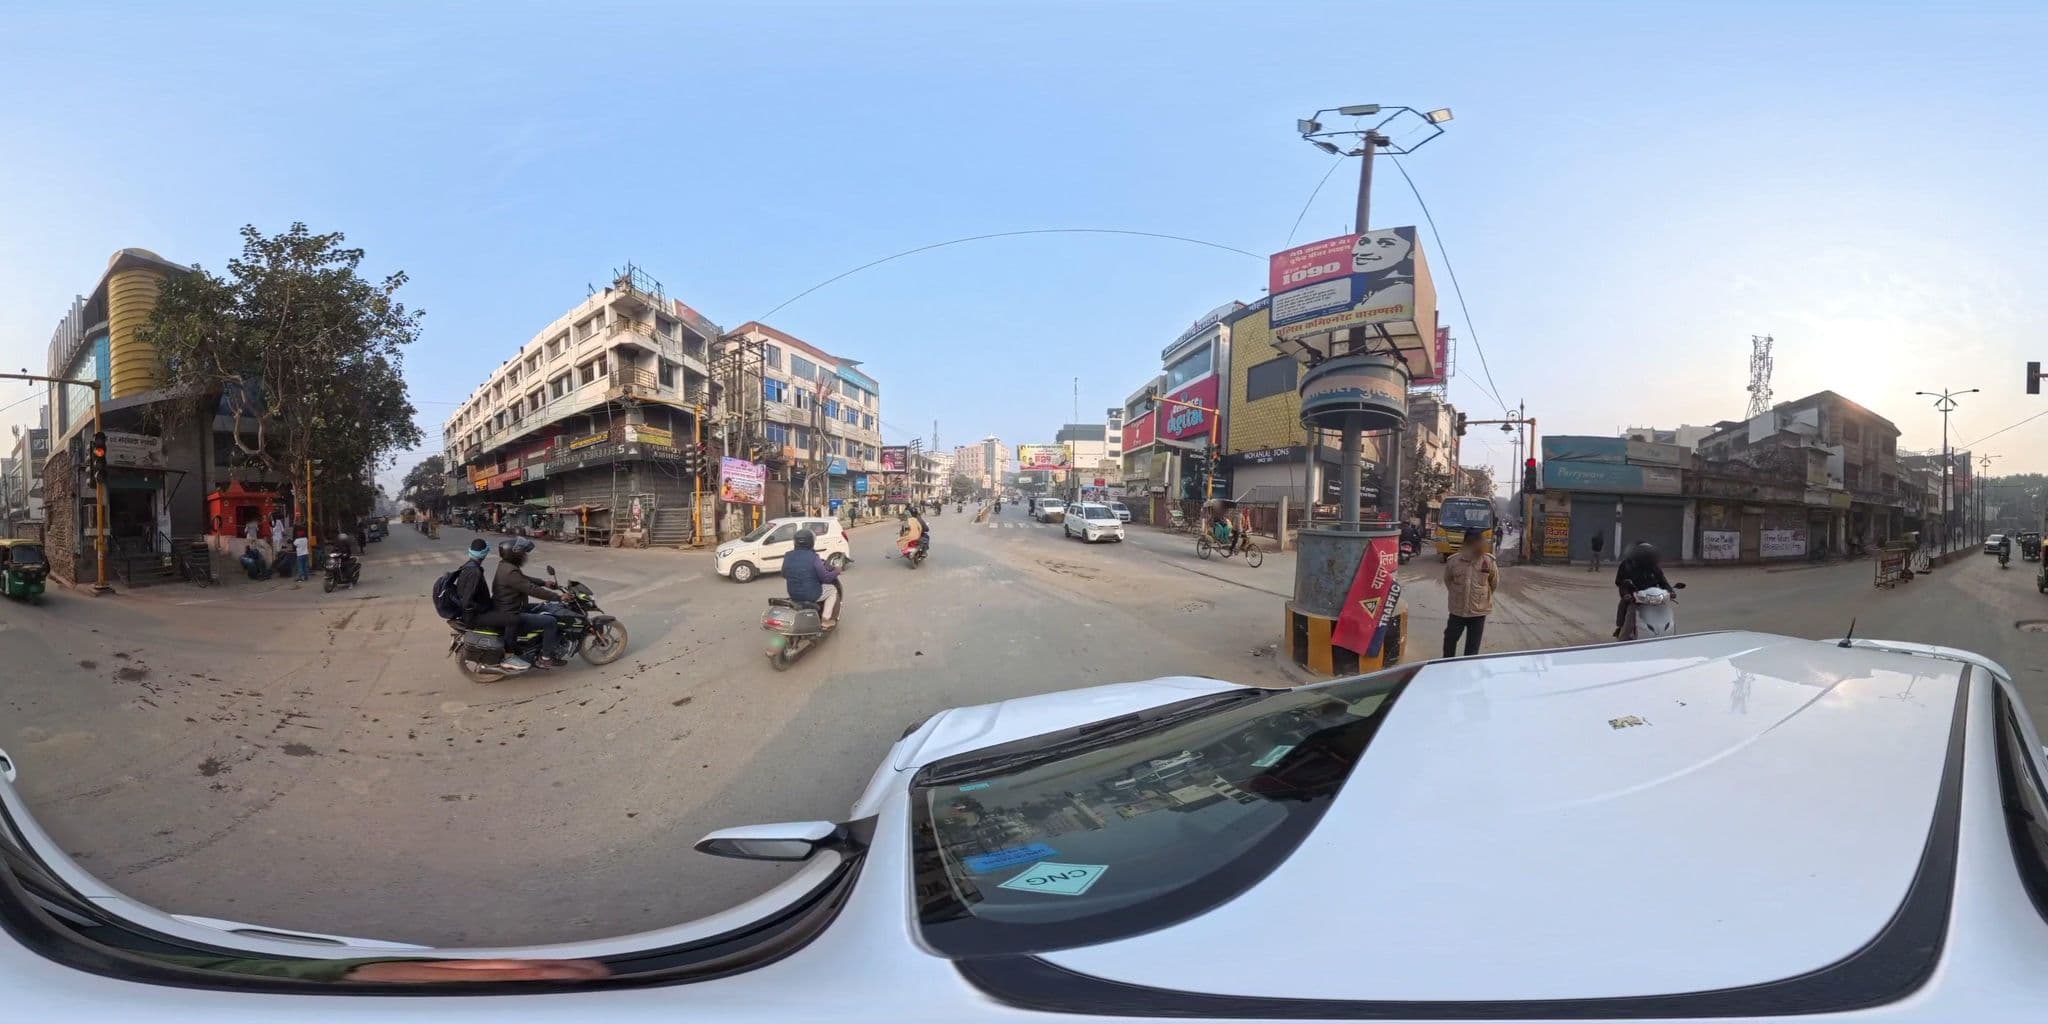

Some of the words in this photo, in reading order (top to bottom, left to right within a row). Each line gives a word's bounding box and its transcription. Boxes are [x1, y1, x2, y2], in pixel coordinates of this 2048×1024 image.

[1282, 262, 1341, 286] 1090
[1275, 324, 1303, 338] पुलिस
[1355, 304, 1404, 318] वाराणसी
[1167, 398, 1205, 435] digital
[1379, 584, 1401, 627] TRAFFIC
[1026, 869, 1088, 886] CNG
